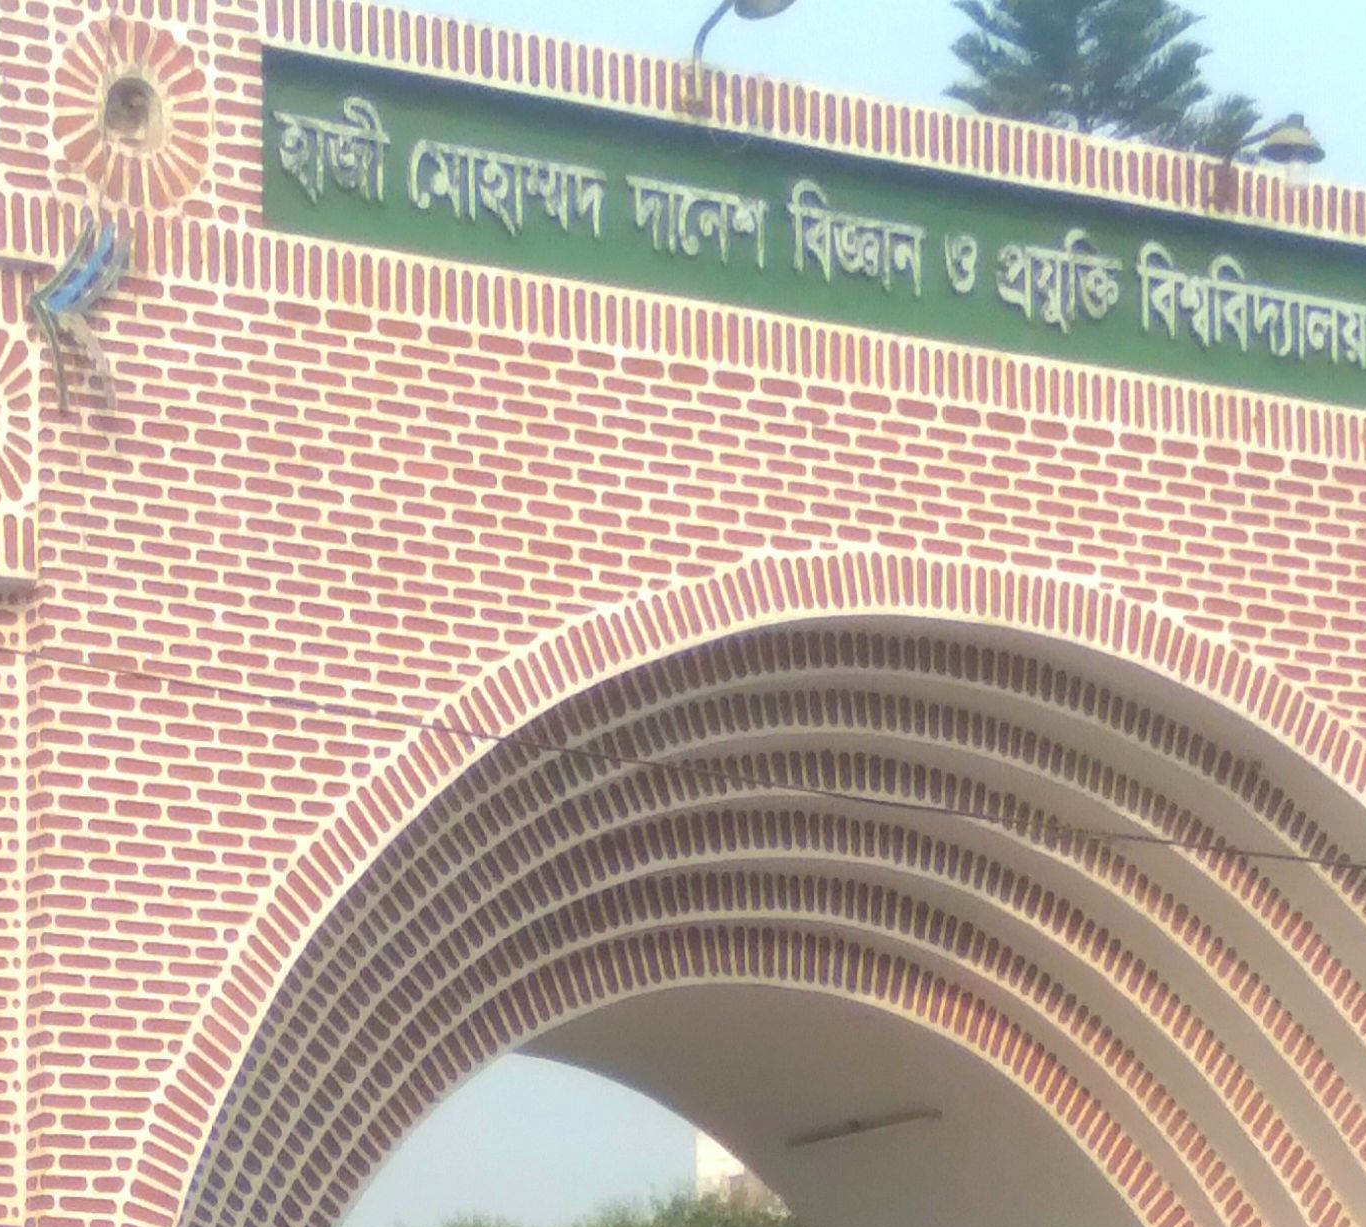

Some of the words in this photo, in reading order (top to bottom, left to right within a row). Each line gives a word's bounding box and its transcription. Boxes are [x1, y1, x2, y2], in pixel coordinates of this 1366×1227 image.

[273, 96, 390, 204] হাজী
[407, 138, 607, 239] মোহাম্মদ
[625, 174, 769, 270] দানেশ
[787, 178, 926, 298] বিজ্ঞান
[944, 233, 978, 294] ও
[996, 228, 1124, 335] প্রযুক্তি
